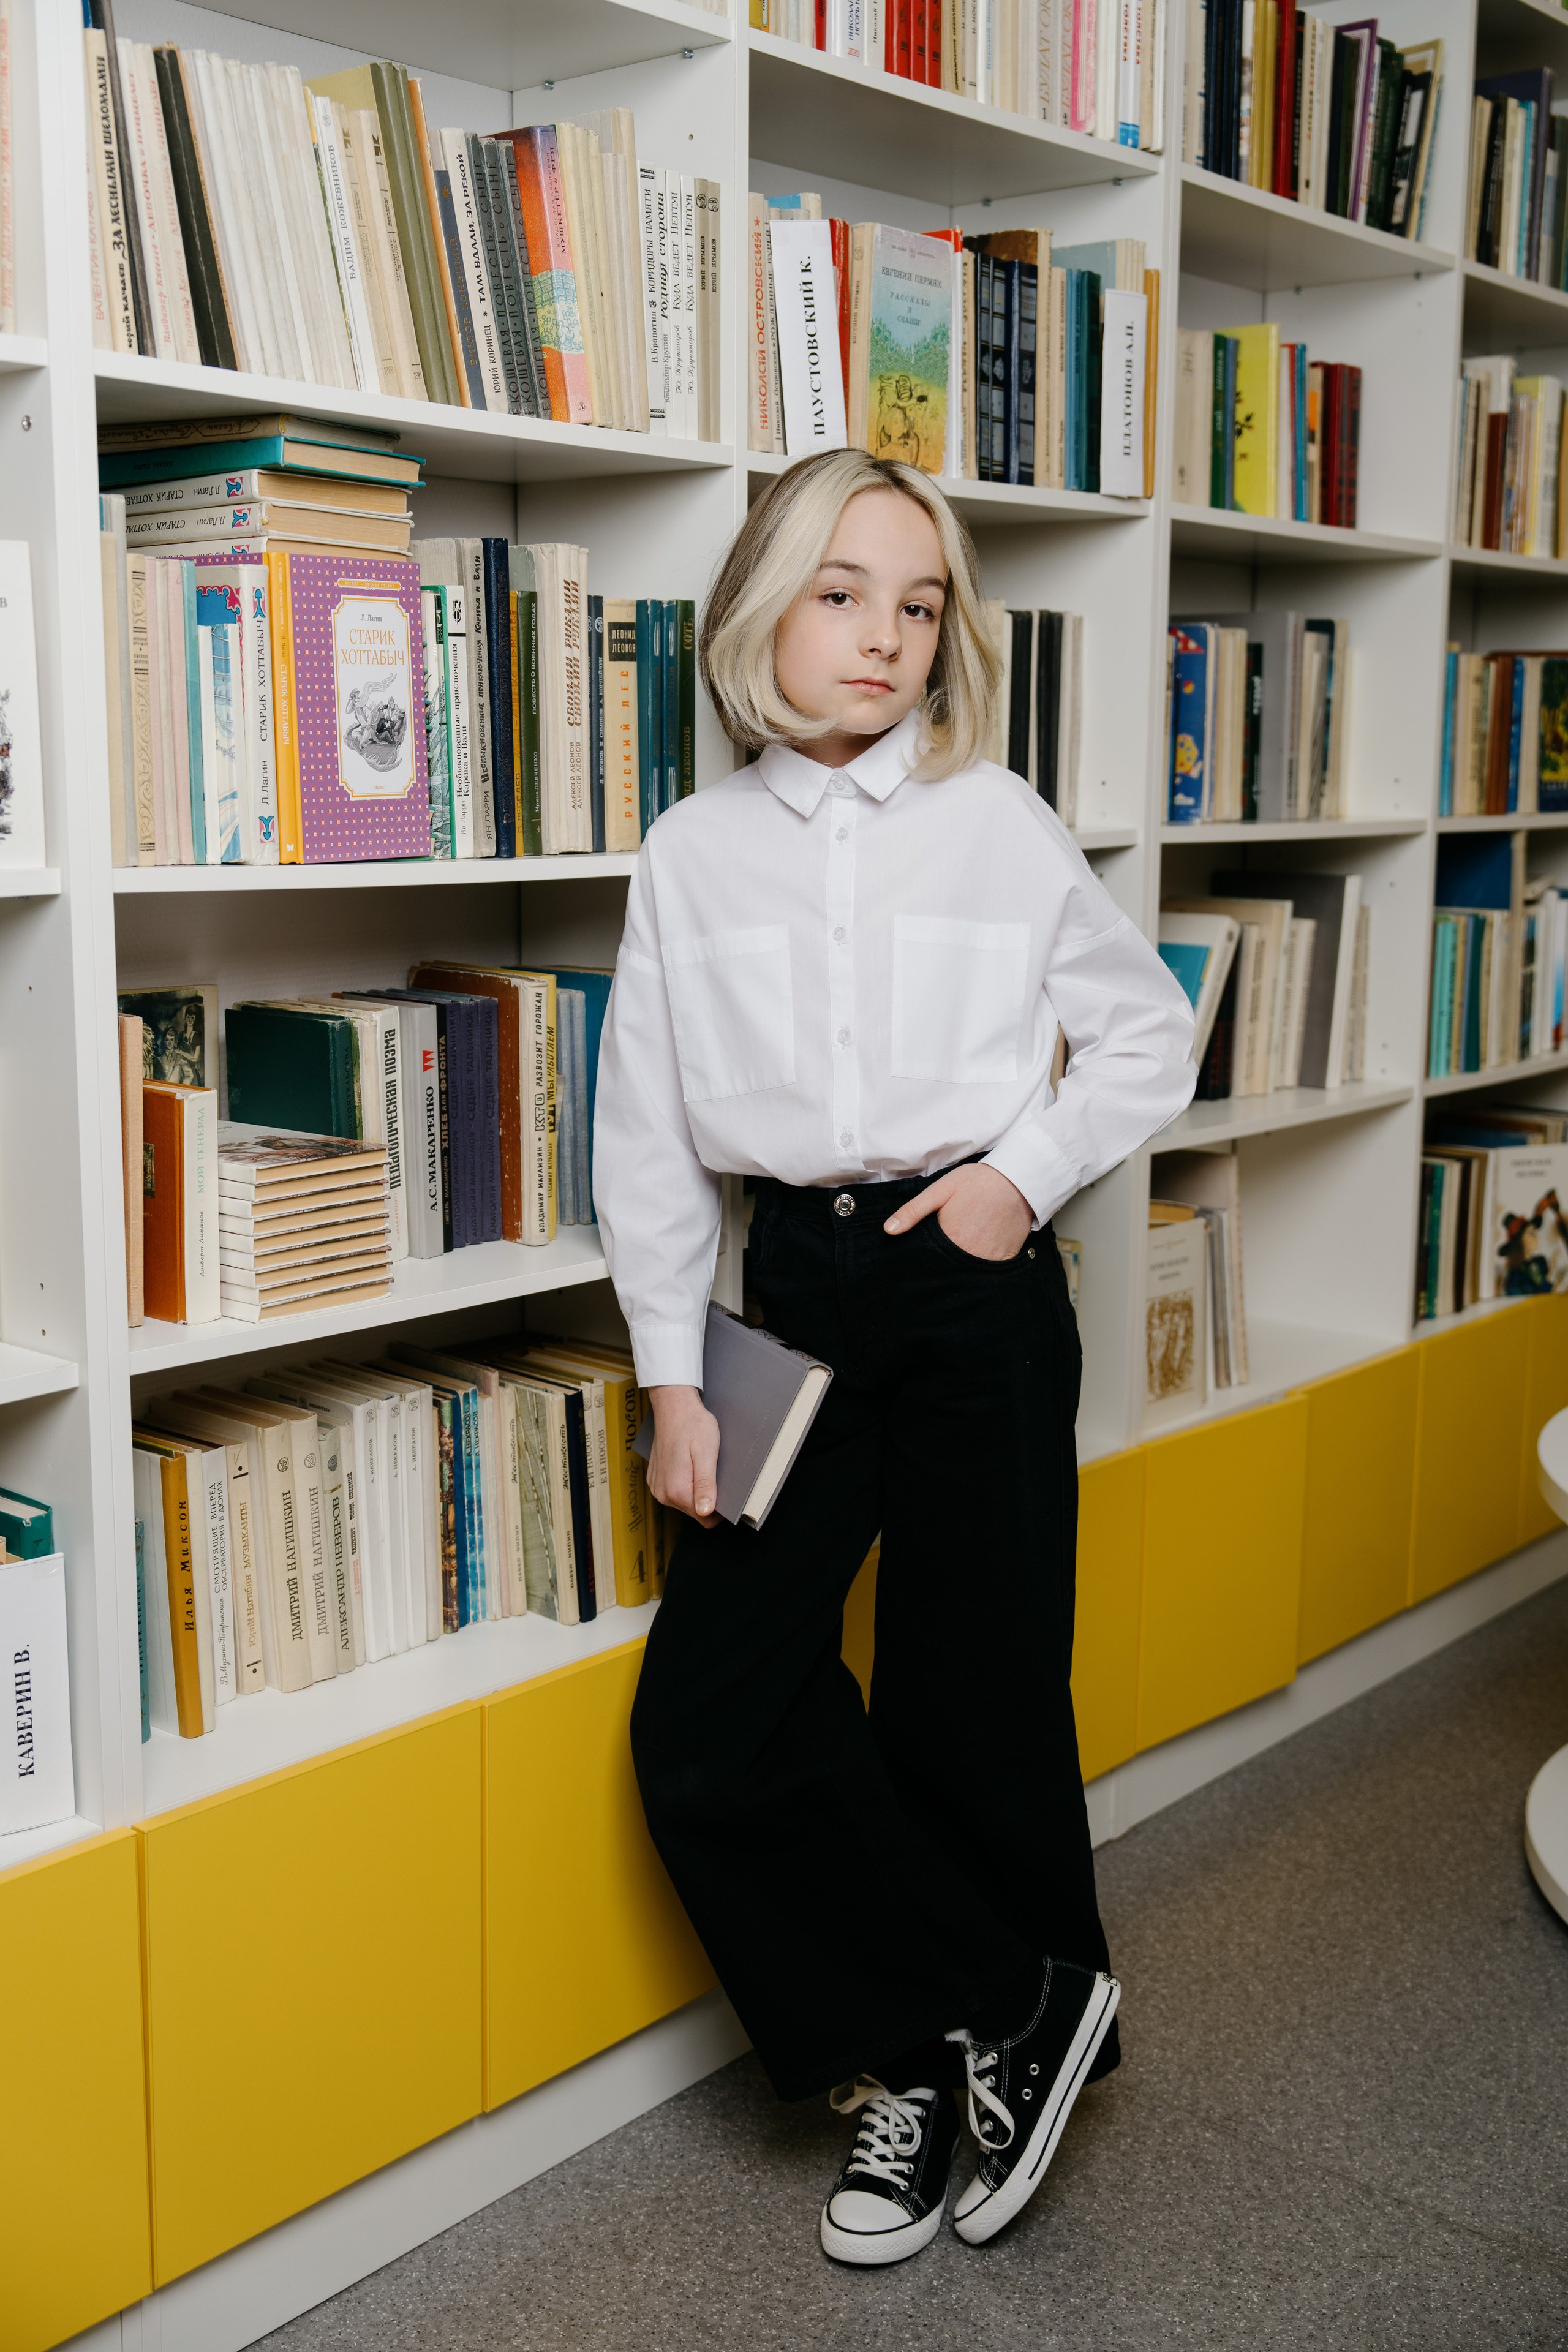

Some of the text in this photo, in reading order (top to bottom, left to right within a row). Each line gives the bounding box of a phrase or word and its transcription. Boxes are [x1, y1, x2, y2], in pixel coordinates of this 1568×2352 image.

[328, 144, 356, 279] ВАДИМ КОЖЕВНИКОВ
[546, 152, 560, 248] ВЛАДИСЛАВ КРАПИВИН
[657, 192, 668, 256] сторона
[140, 161, 172, 343] Владимир ДЕВОЧКА
[456, 154, 502, 394] ЮРИЙ КОРИНЕЦ ТАМ, ВДАЛИ, ЗА РЕКОЙ
[474, 160, 508, 317] ПОВЕСТЬ СЫНЕ
[486, 159, 519, 318] ПОВЕСТЬ СЫНЕ
[450, 236, 478, 366] ВИКТОР КОНЕЦКИЙ
[644, 189, 660, 363] В.Кропотин КОРИДОРЫ ПАМЯТИ
[658, 262, 669, 320] Родная
[881, 266, 943, 288] ЕВГЕНИЙ ПЕРМЯК
[890, 292, 931, 307] РАССКАЗЫ
[686, 326, 696, 377] Крутогоров
[752, 232, 769, 430] НИКОЛАЙ ОСТРОВСКИЙ
[799, 255, 826, 435] ПАУСТОВСКИЙ К.
[897, 315, 921, 327] СКАЗКИ
[674, 325, 684, 394] Ю. Крутогоров
[771, 350, 780, 396] Островский
[1123, 320, 1134, 457] ПЛАТОНОВ А.П.
[156, 484, 221, 502] Л.Лагин СТАРИК
[156, 519, 186, 532] СТАРИК
[349, 629, 396, 646] СТАРИК
[564, 578, 573, 649] РУКАМИ
[571, 579, 581, 650] РУКАМИ
[611, 630, 636, 640] ЛЕОНИД
[611, 643, 636, 654] ЛЕОНОВ
[682, 618, 693, 650] СОТЬ
[256, 620, 268, 742] СТАРИК ХОТТАБЫЧ
[341, 649, 405, 666] ХОТТАБЫЧ
[565, 655, 575, 727] СВОИМИ
[573, 656, 582, 727] СВОИМИ
[281, 699, 290, 745] ХОТТАБЫЧ
[451, 643, 463, 797] Необыкновенные приключения
[620, 671, 633, 818] РУССКИЙ ЛЕС
[461, 761, 470, 797] Карика
[461, 824, 467, 835] Ян
[483, 791, 493, 839] ЯН ЛАРРИ
[534, 992, 543, 1035] ГОРОЖАН
[439, 1035, 448, 1091] ФРОНТА
[466, 1012, 476, 1121] СЕДЫЕ ТАЛЬНИКИ
[484, 1011, 495, 1120] СЕДЫЕ ТАЛЬНИКИ
[535, 1041, 543, 1087] РАЗВОЗИТ
[546, 1025, 555, 1101] МЫ РАБОТАЕМ
[383, 1029, 402, 1190] ПЕДАГОГИЧЕСКАЯ ПОЭМА
[440, 1112, 449, 1150] ХЛЕБ
[448, 1010, 461, 1237] АНАТОЛИЙ МАКСИМОВ СЕДЫЕ ТАЛЬНИКИ
[534, 1093, 545, 1132] КТО
[426, 1085, 438, 1212] А.С.МАКАРЕНКО
[510, 1418, 518, 1484] Жестокость
[560, 1423, 570, 1491] Жестокость
[179, 1500, 194, 1631] Илья Миксон
[209, 1483, 221, 1594] СМОТРЯЩИЕ ВПЕРЕД
[218, 1524, 228, 1591] ОБСЕРВАТОРИЯ
[282, 1490, 304, 1641] ДМИТРИЙ НАГИШКИН
[309, 1485, 330, 1635] ДМИТРИЙ НАГИШКИН
[332, 1496, 350, 1651] АЛЕКСАНДР НЕВЕРОВ
[628, 1550, 648, 1585] 4
[239, 1501, 256, 1648] Юрий Нагибин МУЗЫКАНТЫ
[13, 1644, 35, 1779] КАВЕРИН В.
